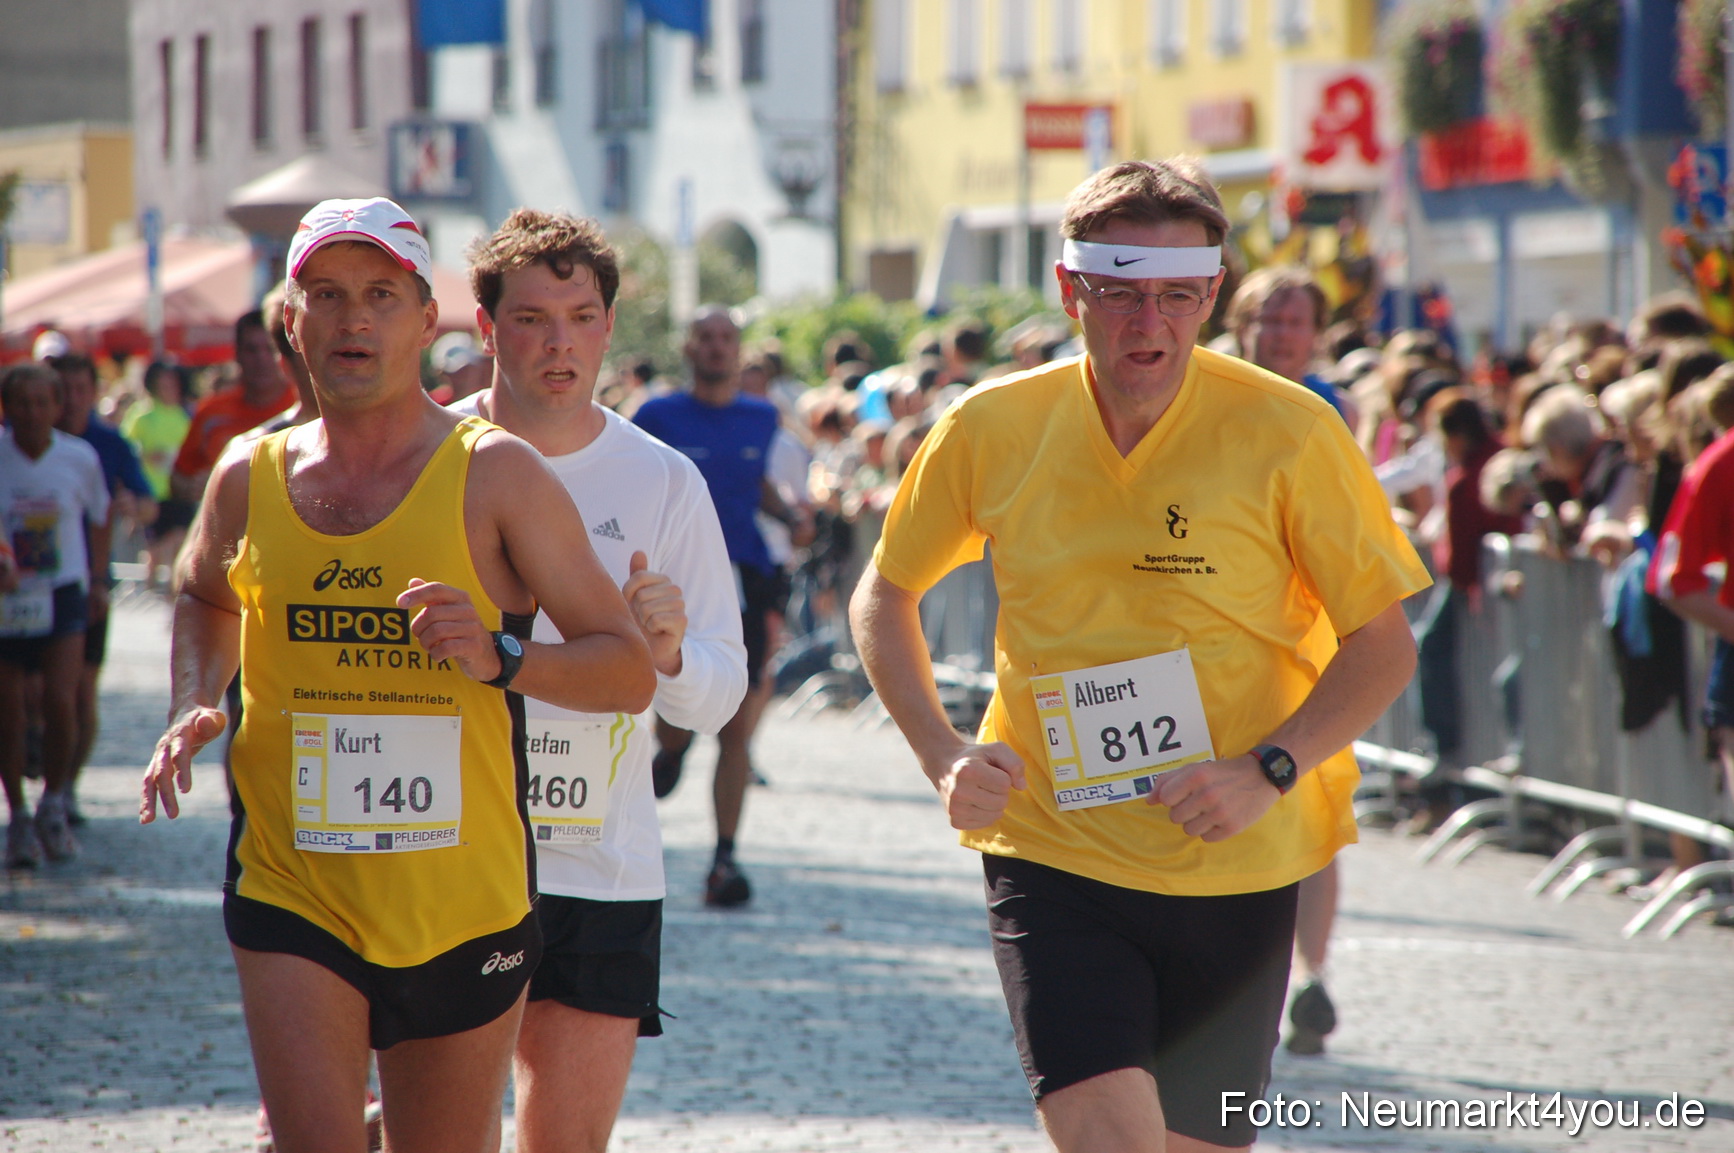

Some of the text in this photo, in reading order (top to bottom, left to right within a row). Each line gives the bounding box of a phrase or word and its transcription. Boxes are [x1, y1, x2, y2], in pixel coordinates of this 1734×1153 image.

[593, 528, 624, 541] adidas
[1144, 554, 1206, 564] SportGruppe
[1132, 564, 1218, 575] Neunkirchen a. Br.
[294, 610, 404, 640] SIPOS
[293, 688, 454, 706] Elektrische Stellantriebe
[1074, 677, 1138, 708] Albert
[334, 727, 382, 754] Kurt
[525, 731, 571, 755] tefan
[1047, 727, 1059, 746] C
[1100, 715, 1182, 763] 812
[298, 767, 308, 786] C
[353, 776, 433, 814] 140
[527, 774, 588, 810] 460
[1057, 783, 1114, 804] BOCK
[296, 830, 354, 846] BOCK
[394, 828, 456, 844] PFLEIDERER
[553, 824, 601, 837] PFLEIDERER
